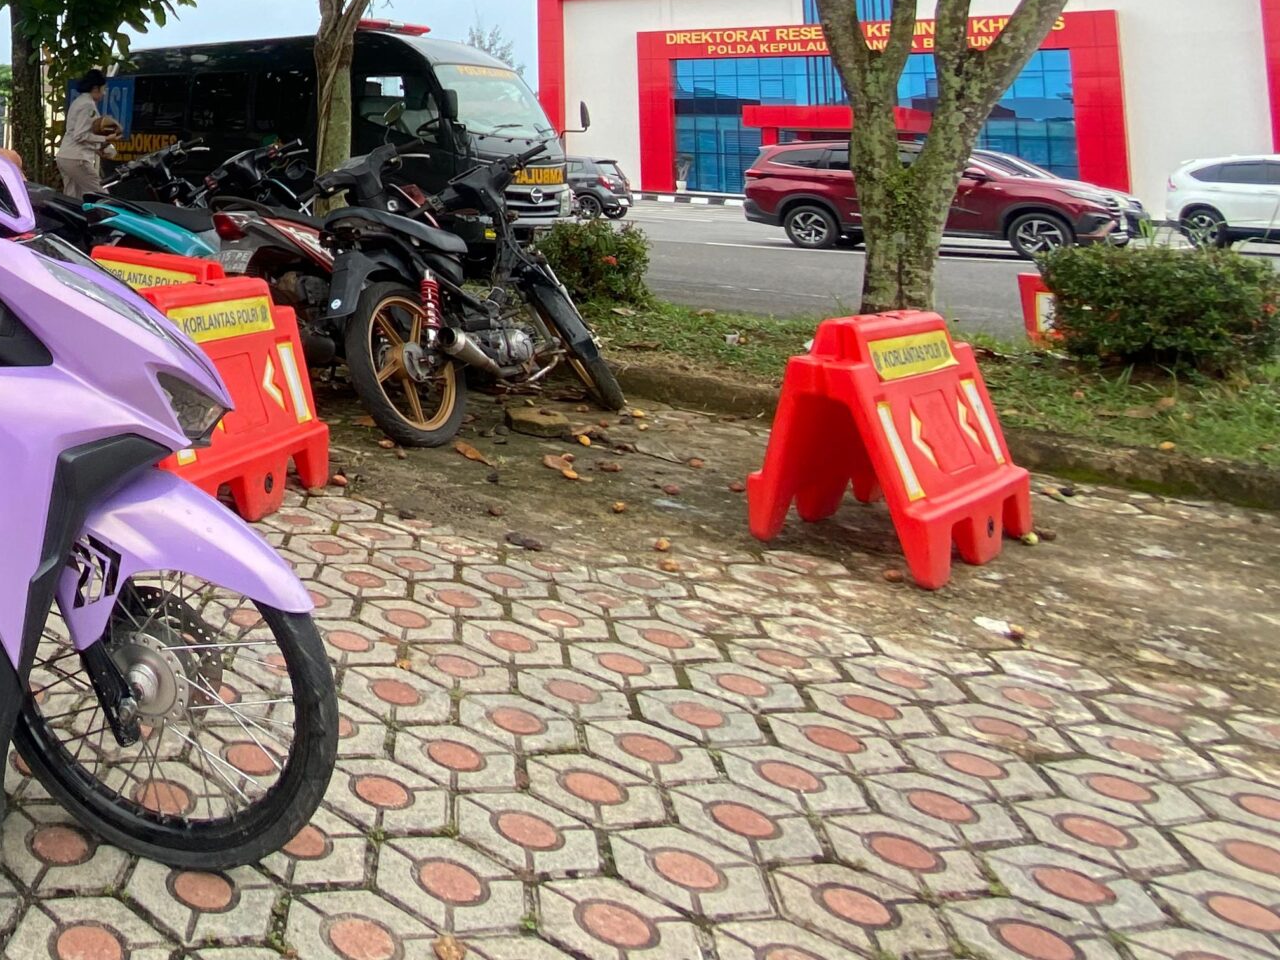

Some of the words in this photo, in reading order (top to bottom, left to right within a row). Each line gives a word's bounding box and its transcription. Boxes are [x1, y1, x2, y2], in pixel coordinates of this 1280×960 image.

[665, 29, 770, 45] DIREKTORAT
[775, 26, 823, 41] RESE
[707, 44, 758, 55] POLDA
[760, 41, 827, 54] KEPULAU
[182, 310, 237, 334] KORLANTAS
[237, 307, 259, 325] POLRI
